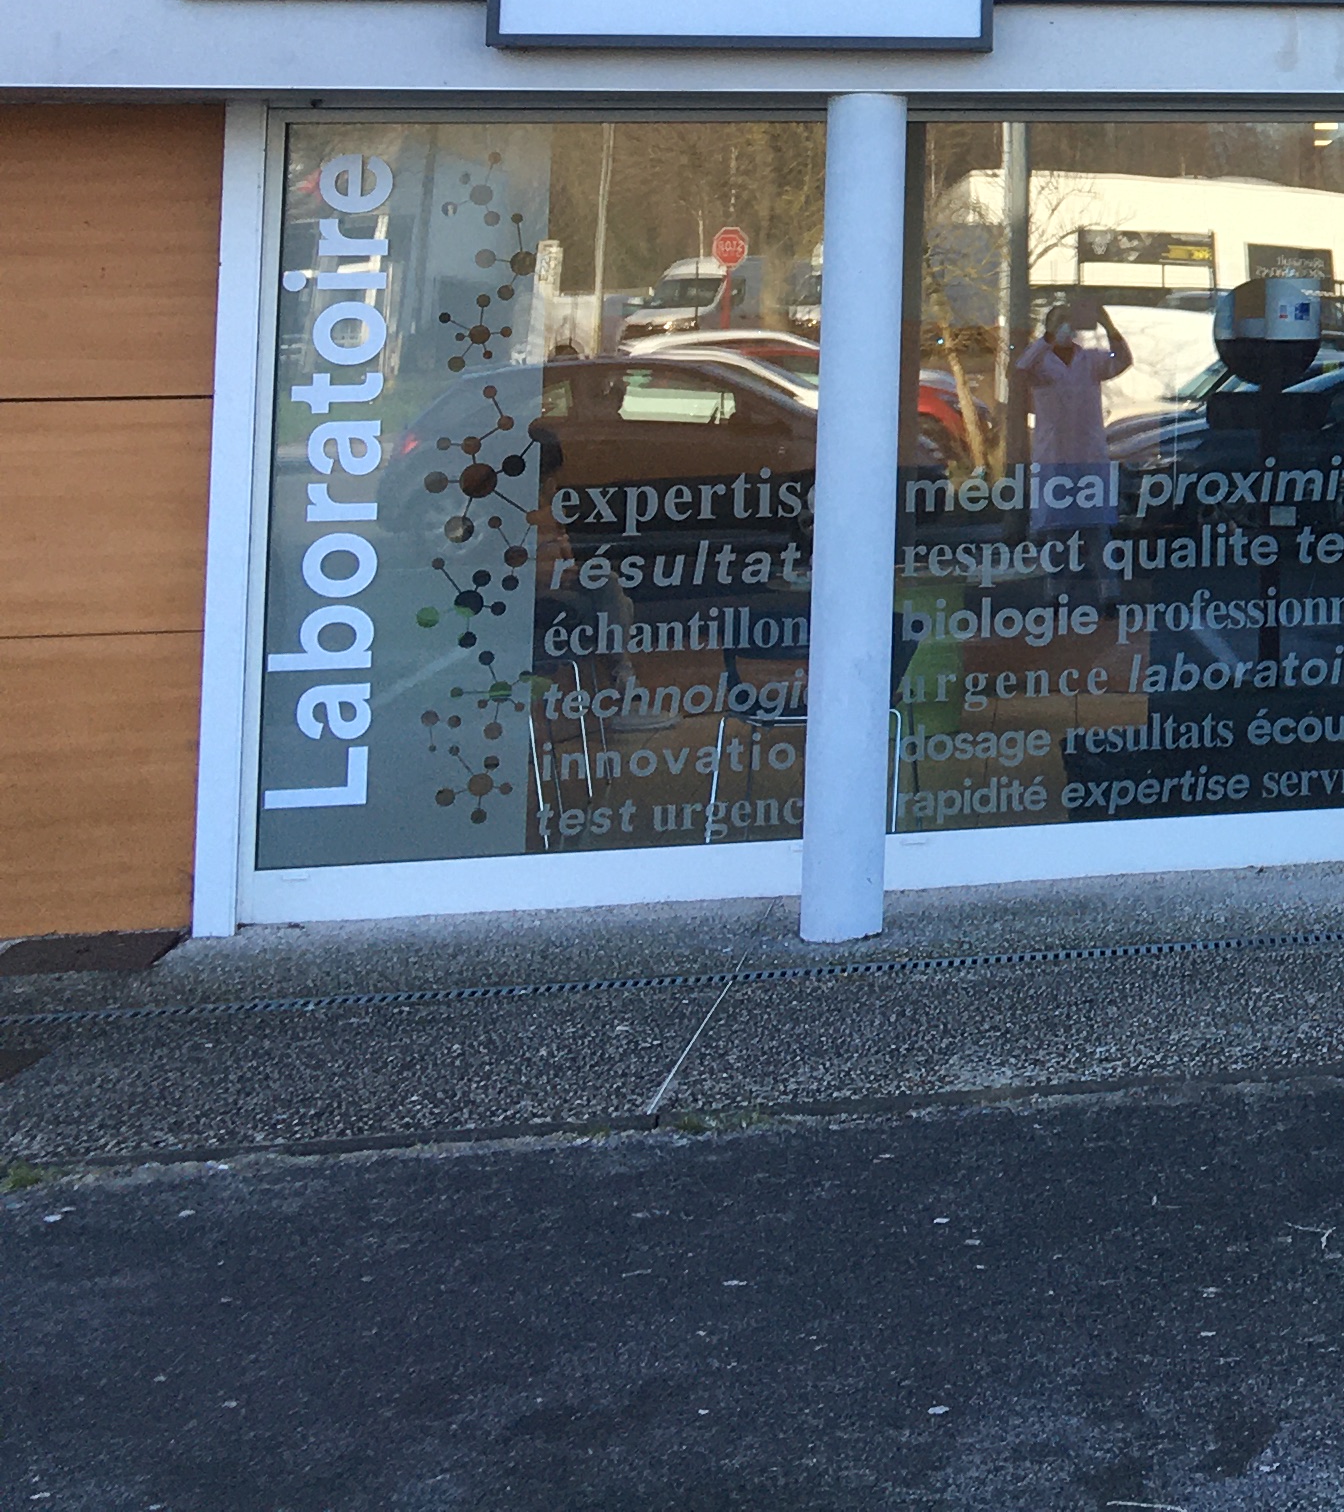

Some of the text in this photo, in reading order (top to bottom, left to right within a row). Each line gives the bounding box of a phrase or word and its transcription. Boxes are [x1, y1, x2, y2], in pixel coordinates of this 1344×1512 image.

[264, 152, 394, 809] Laboratoire
[551, 467, 816, 536] expertis
[905, 461, 1119, 513] médical
[550, 540, 813, 589] résultat
[902, 530, 1085, 588] respect
[1102, 523, 1279, 580] qualite
[902, 593, 1098, 647] biologie
[543, 668, 808, 719] technologi
[902, 665, 1108, 712] urgence
[542, 732, 797, 781] innovatio
[899, 724, 1051, 767] dosage
[1064, 713, 1234, 755] resultats
[536, 797, 804, 838] test urgenc
[898, 776, 1048, 824] rapidité
[1061, 765, 1250, 814] expertise
